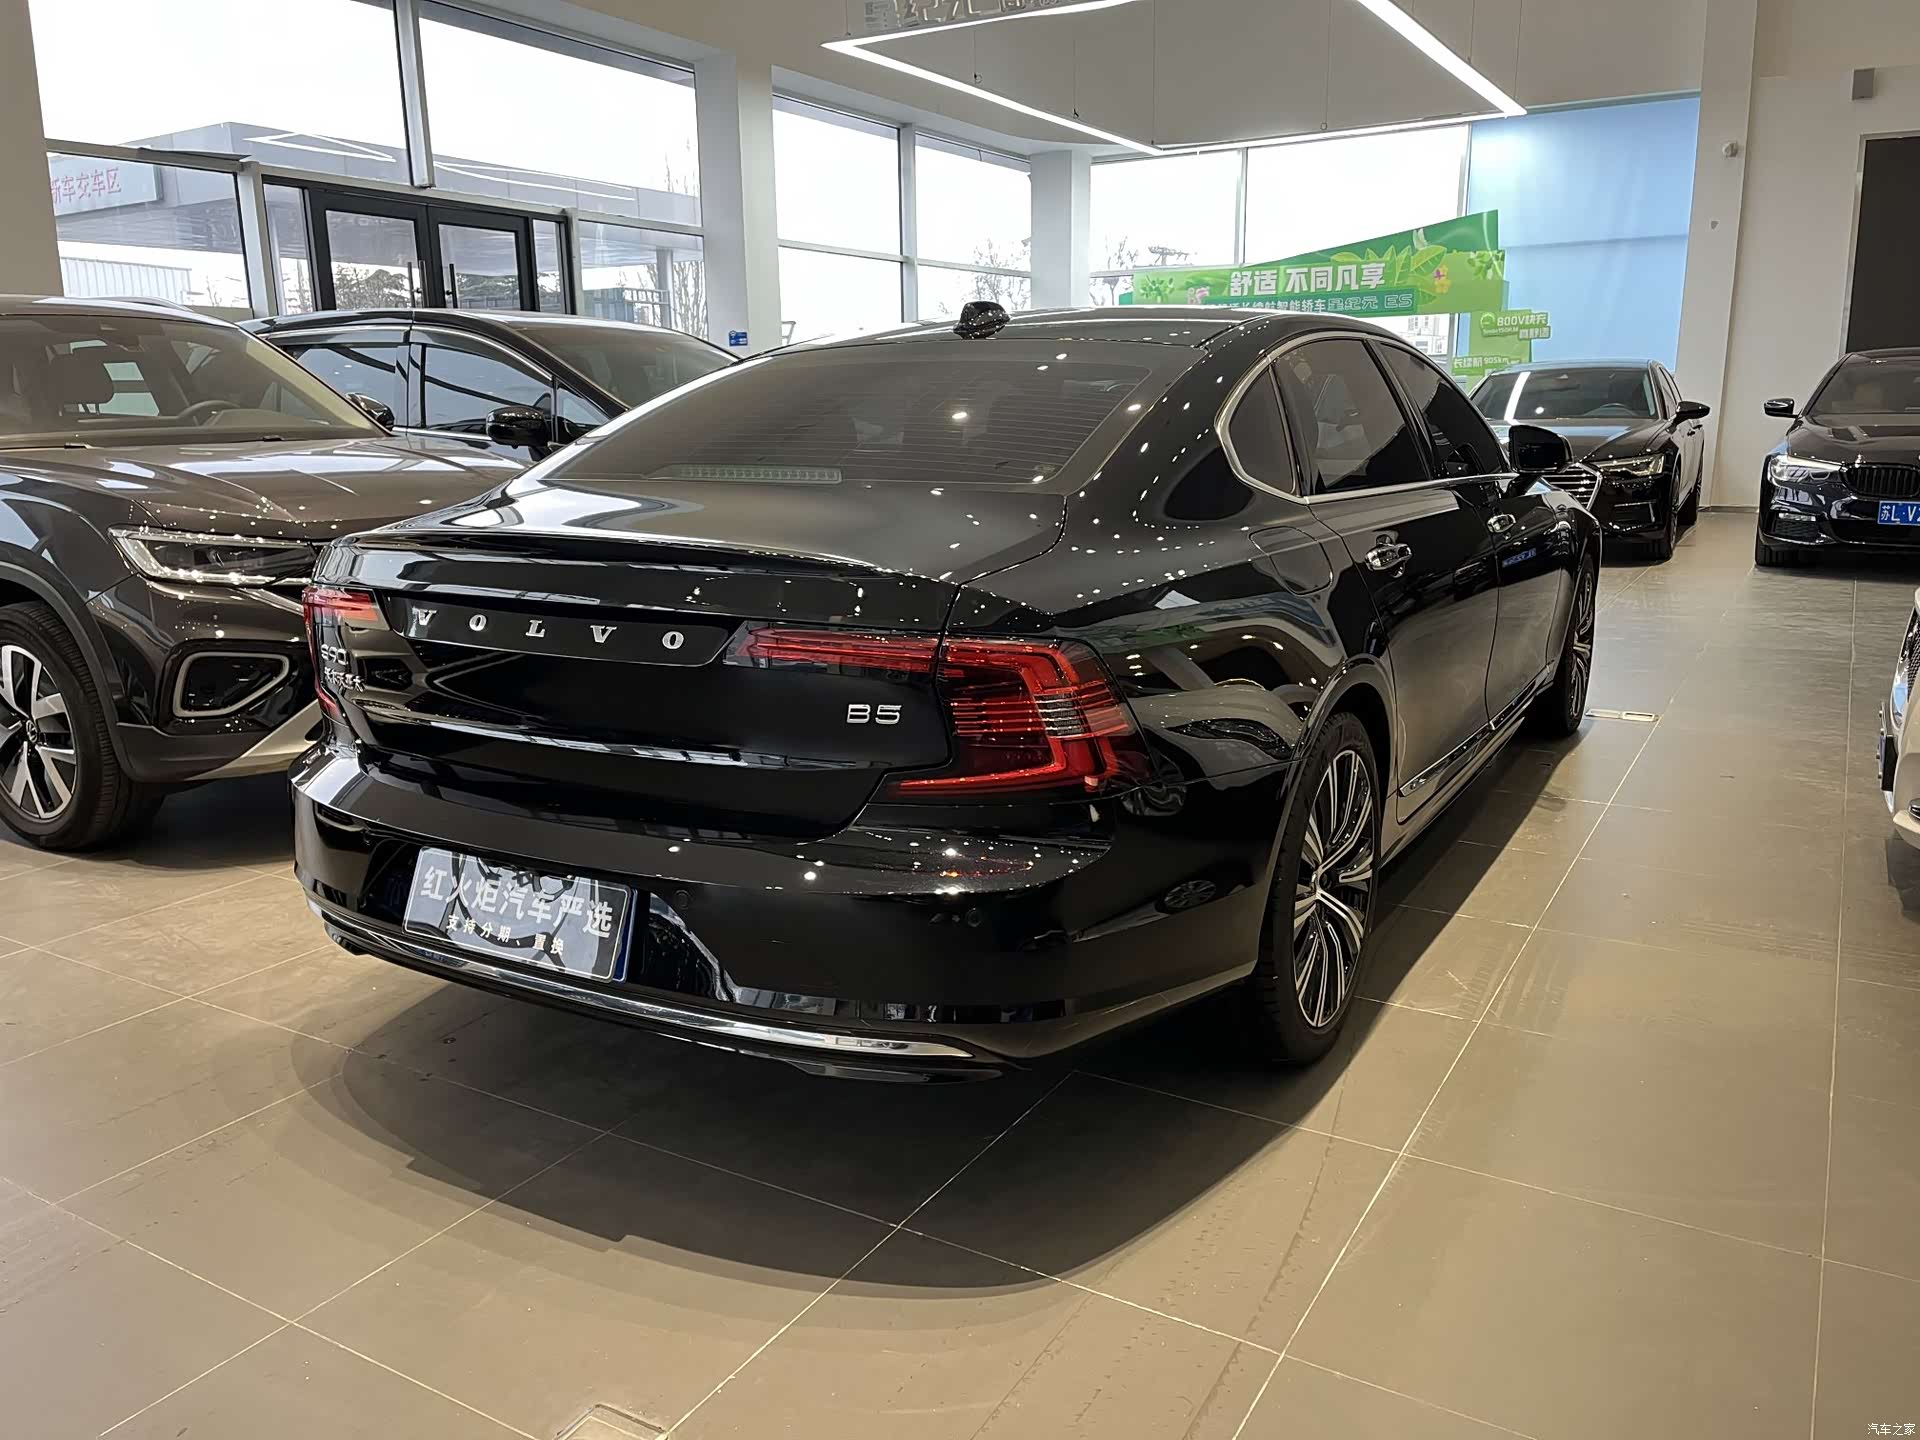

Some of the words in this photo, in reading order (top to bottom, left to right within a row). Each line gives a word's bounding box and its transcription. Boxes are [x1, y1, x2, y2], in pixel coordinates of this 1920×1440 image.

[1230, 269, 1277, 297] 舒适
[1285, 262, 1386, 293] 不同凡享
[1384, 293, 1413, 309] ES
[411, 607, 685, 651] VOLVO
[847, 704, 902, 725] B5
[420, 865, 614, 939] 红火炬汽车严选
